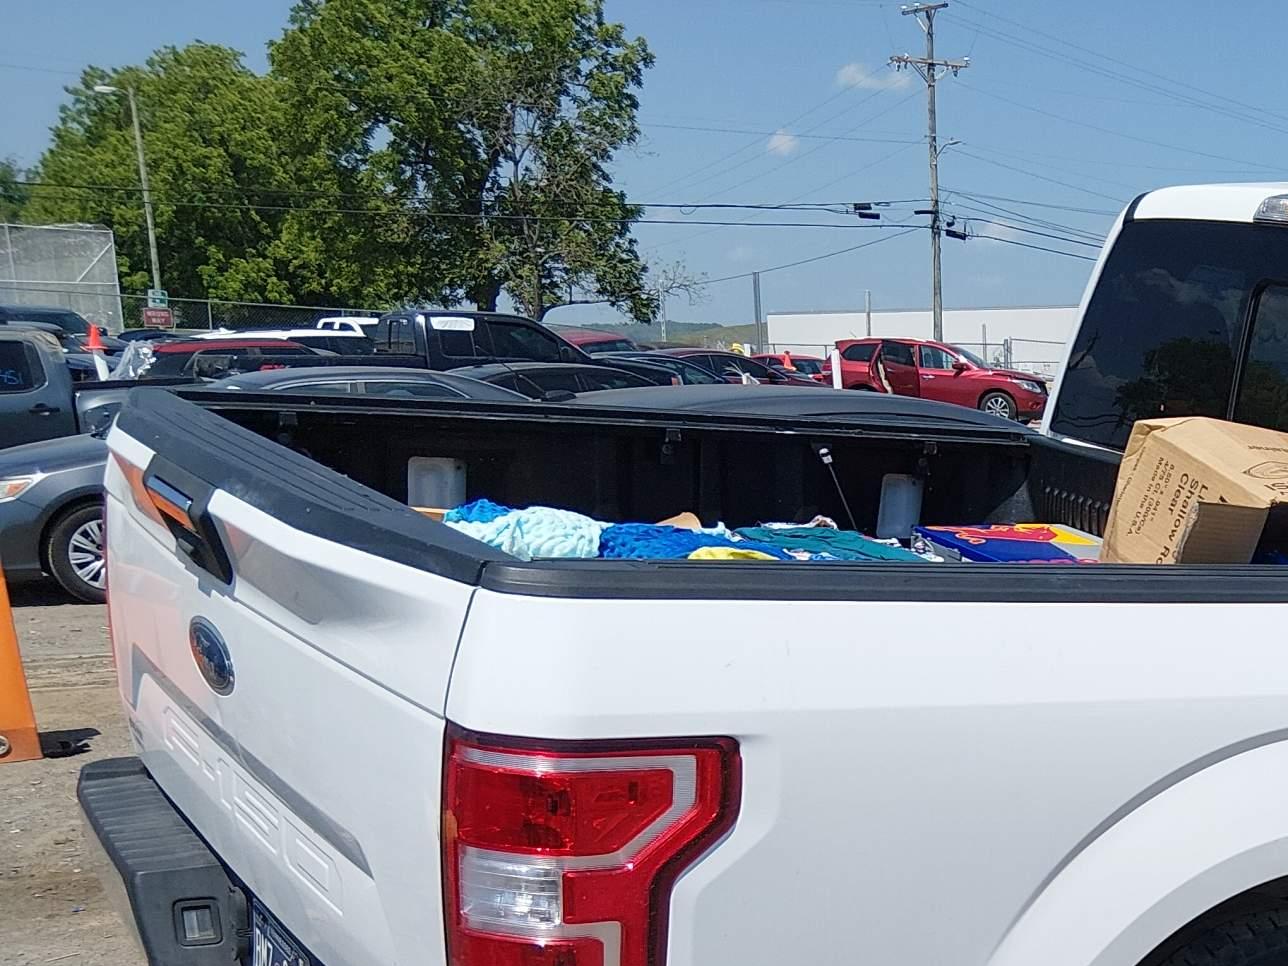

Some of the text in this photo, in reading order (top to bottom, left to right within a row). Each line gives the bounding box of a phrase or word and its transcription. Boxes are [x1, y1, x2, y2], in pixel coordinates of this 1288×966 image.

[1155, 478, 1199, 564] Shallow Ro
[1168, 473, 1189, 516] Clear
